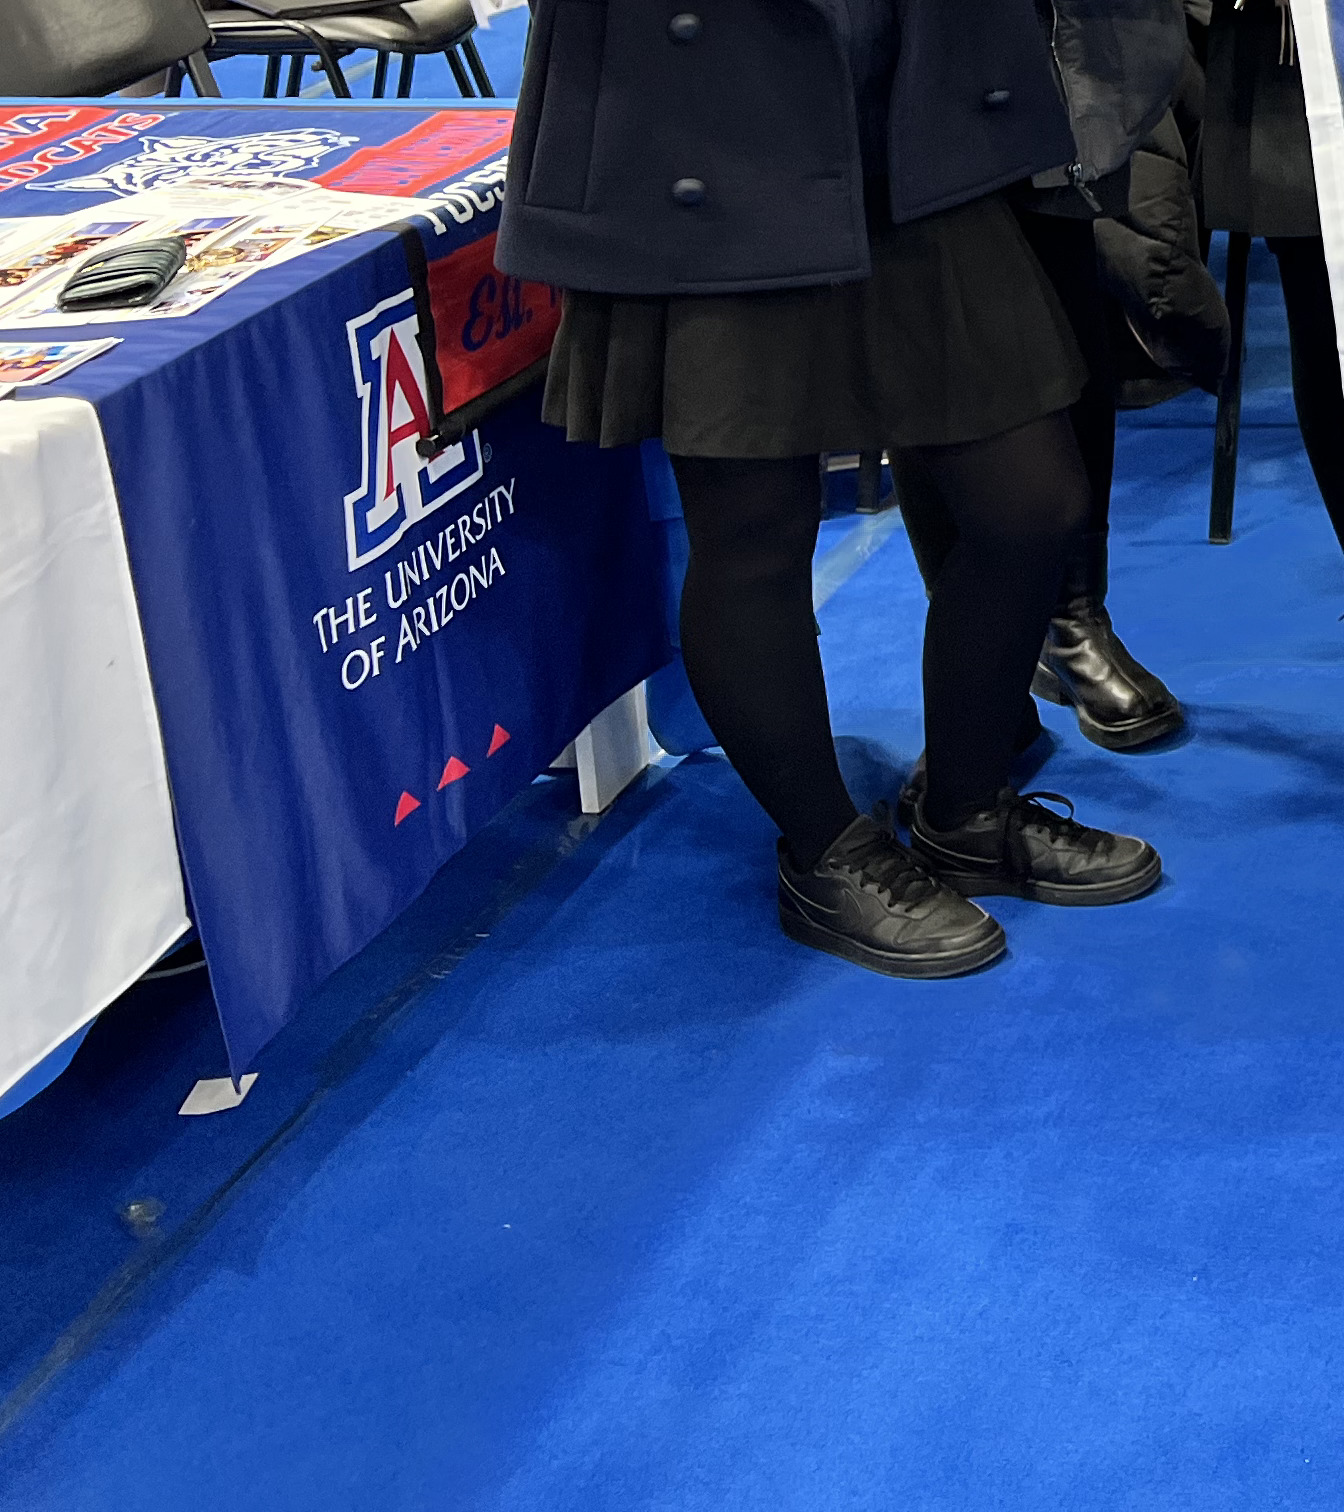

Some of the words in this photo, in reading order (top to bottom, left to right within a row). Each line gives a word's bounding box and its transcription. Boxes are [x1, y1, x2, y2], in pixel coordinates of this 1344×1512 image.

[312, 587, 378, 654] THE
[384, 477, 516, 610] UNIVERSITY
[340, 635, 387, 690] OF
[394, 546, 506, 665] ARIZONA
